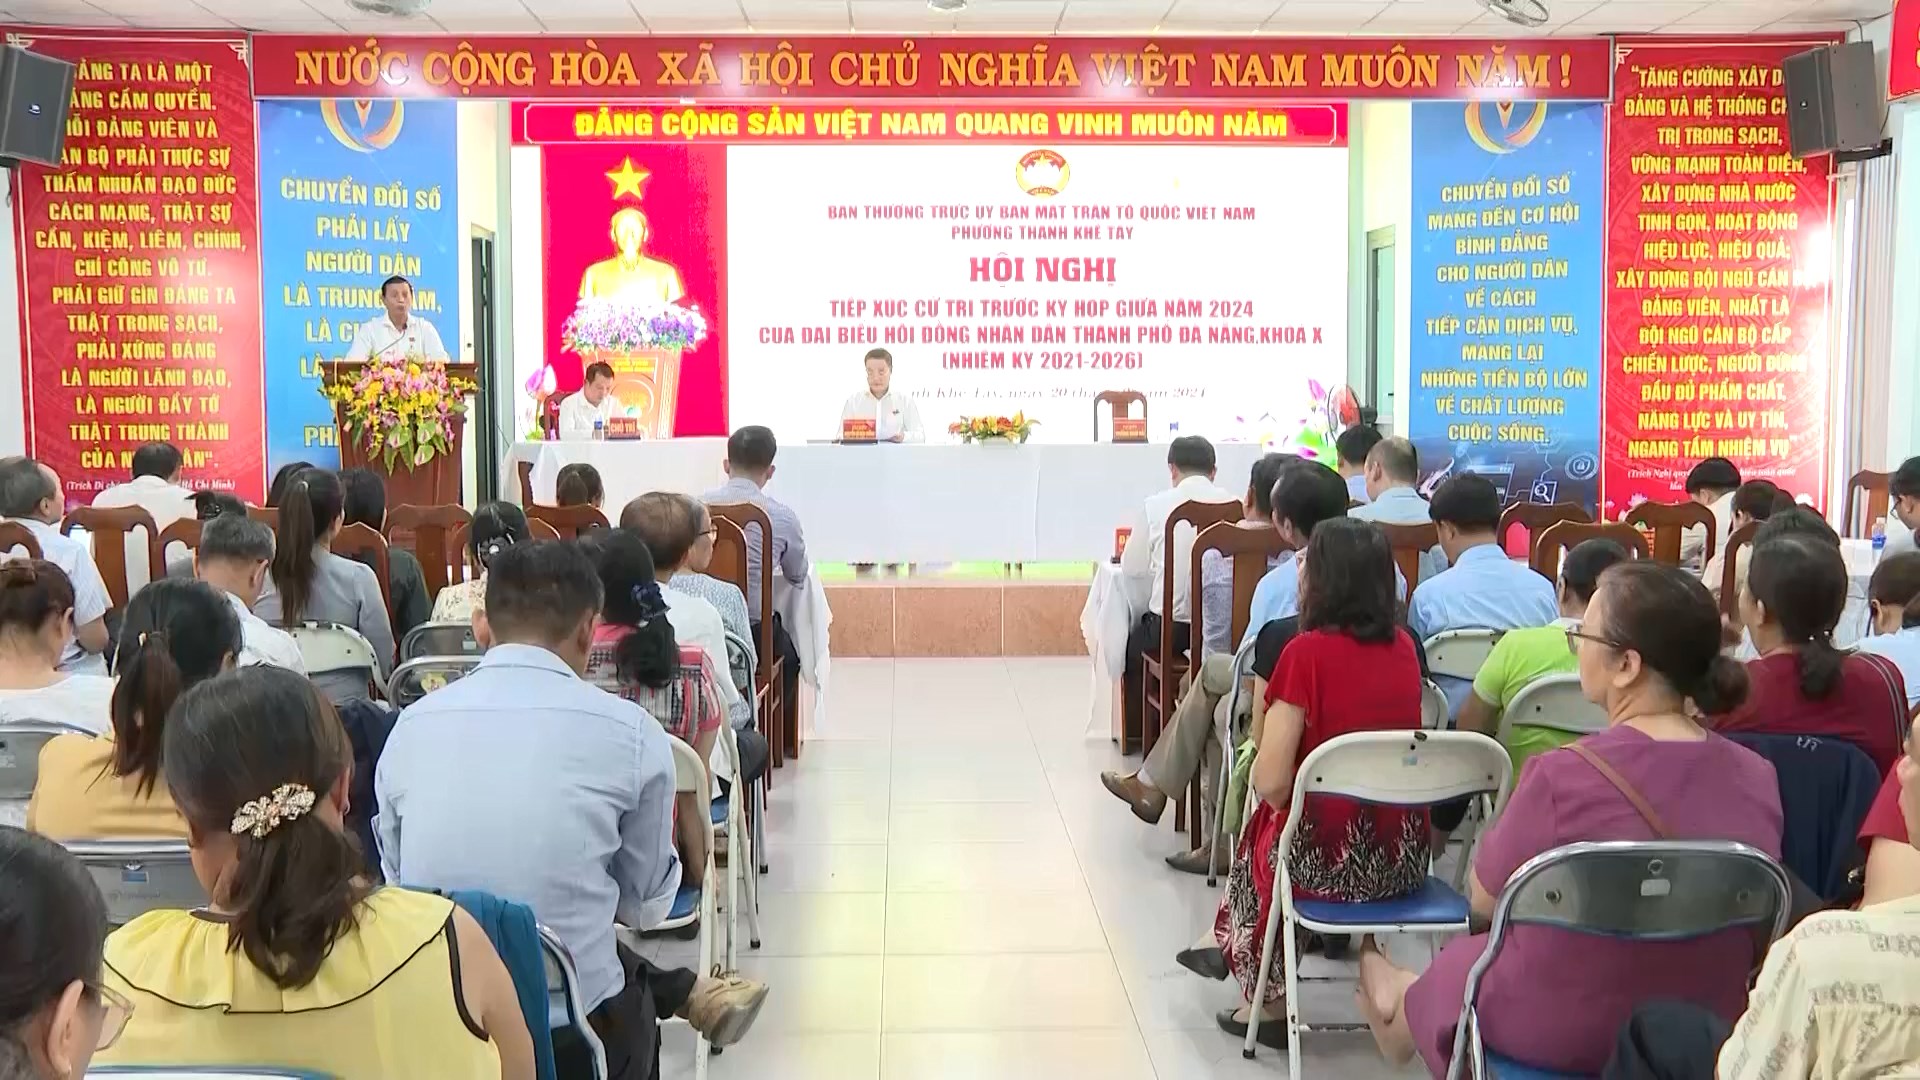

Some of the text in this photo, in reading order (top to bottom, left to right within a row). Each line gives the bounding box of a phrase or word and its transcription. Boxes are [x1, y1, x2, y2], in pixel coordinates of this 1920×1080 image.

[119, 61, 212, 85] TA LÀ MỘT
[295, 37, 409, 86] NƯỚC
[422, 41, 536, 94] CỘNG
[550, 38, 640, 86] HÒA
[657, 42, 722, 86] XÃ
[740, 40, 814, 94] HỘI
[829, 39, 920, 87] CHỦ
[939, 44, 1080, 87] NGHĨA
[1090, 44, 1197, 94] VIỆT
[1211, 53, 1308, 88] NAM
[1322, 45, 1440, 89] MUÔN
[1456, 44, 1550, 88] NĂM
[1738, 65, 1768, 86] XÂY
[1624, 93, 1665, 116] ĐẢNG
[1670, 96, 1689, 116] VÀ
[1694, 95, 1712, 120] HỆ
[97, 115, 218, 138] ĐẢNG VIÊN VÀ
[574, 104, 1288, 141] ĐẢNG CỘNG SẢN VIỆT NAM QUANG VINH MUÔN NĂM
[1657, 127, 1783, 148] TRỊ TRONG SẠCH,
[87, 145, 109, 169] BỘ
[116, 143, 155, 166] PHẢI
[161, 146, 203, 169] THỰC
[1676, 156, 1720, 177] MẠNH
[1725, 152, 1764, 174] TOÀN
[162, 176, 197, 197] ĐẠO
[1641, 181, 1670, 202] XÂY
[1720, 182, 1749, 202] NHÀ
[828, 206, 1256, 220] BAN BAN NAM
[1428, 212, 1477, 231] MANG
[379, 251, 421, 277] DÂN
[970, 252, 1116, 288] HỘI NGHỊ
[1437, 265, 1469, 282] CHO
[1532, 258, 1568, 279] DÂN
[1616, 267, 1645, 288] XÂY
[216, 287, 236, 304] TA
[283, 283, 311, 308] LÀ
[944, 300, 1253, 318] TRI 2024
[117, 315, 169, 333] TRONG
[1312, 327, 1322, 344] X
[1462, 344, 1512, 362] MANG
[1738, 412, 1757, 430] UY
[118, 424, 170, 441] TRUNG
[1628, 440, 1679, 458] NGANG
